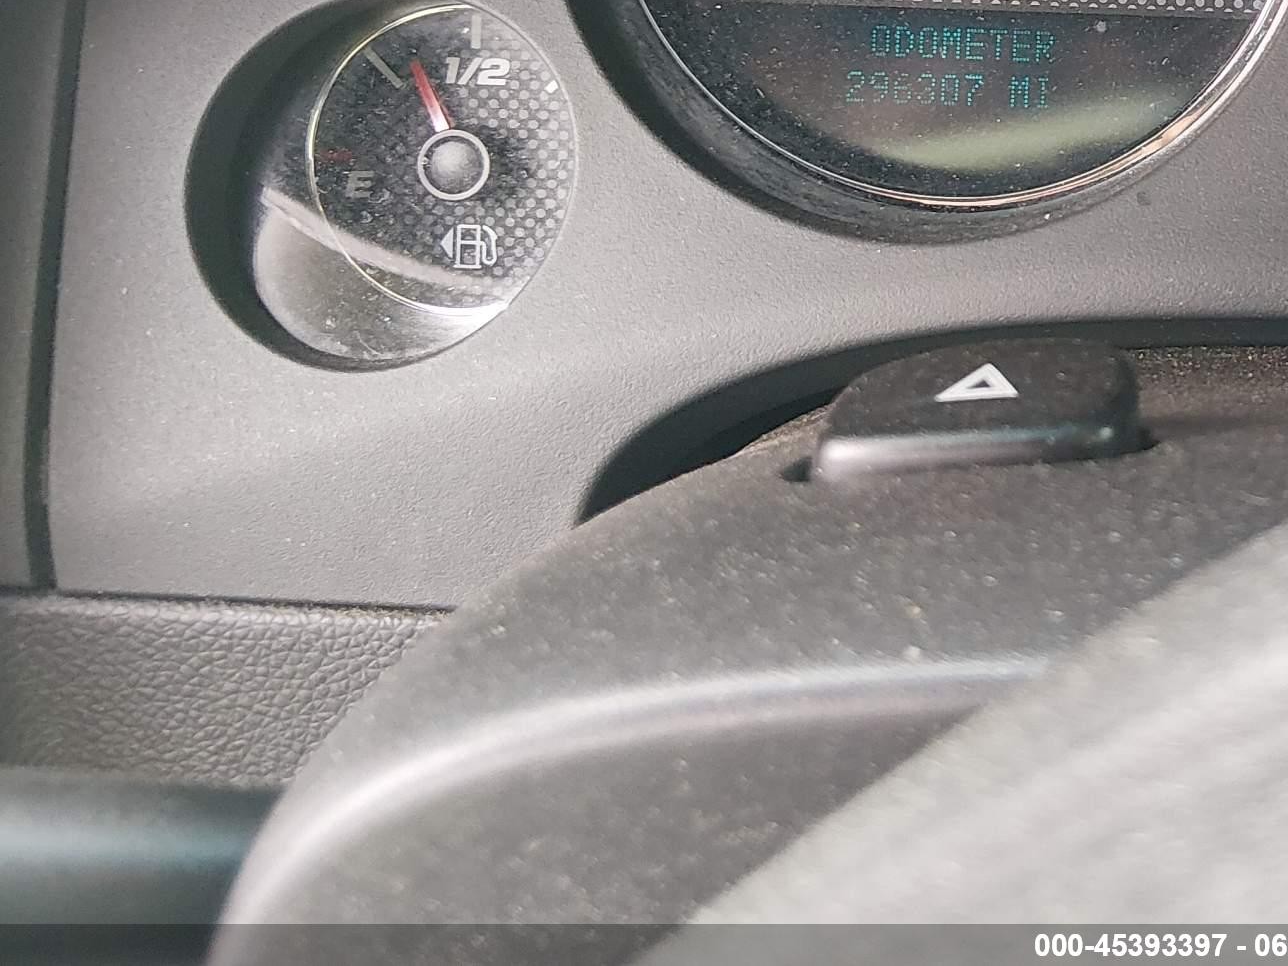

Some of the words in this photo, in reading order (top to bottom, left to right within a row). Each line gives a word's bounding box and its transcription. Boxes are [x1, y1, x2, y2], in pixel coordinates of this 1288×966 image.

[871, 25, 1057, 63] ODOMETER
[445, 56, 511, 86] 1/2
[1008, 76, 1049, 109] MI
[345, 170, 373, 199] E
